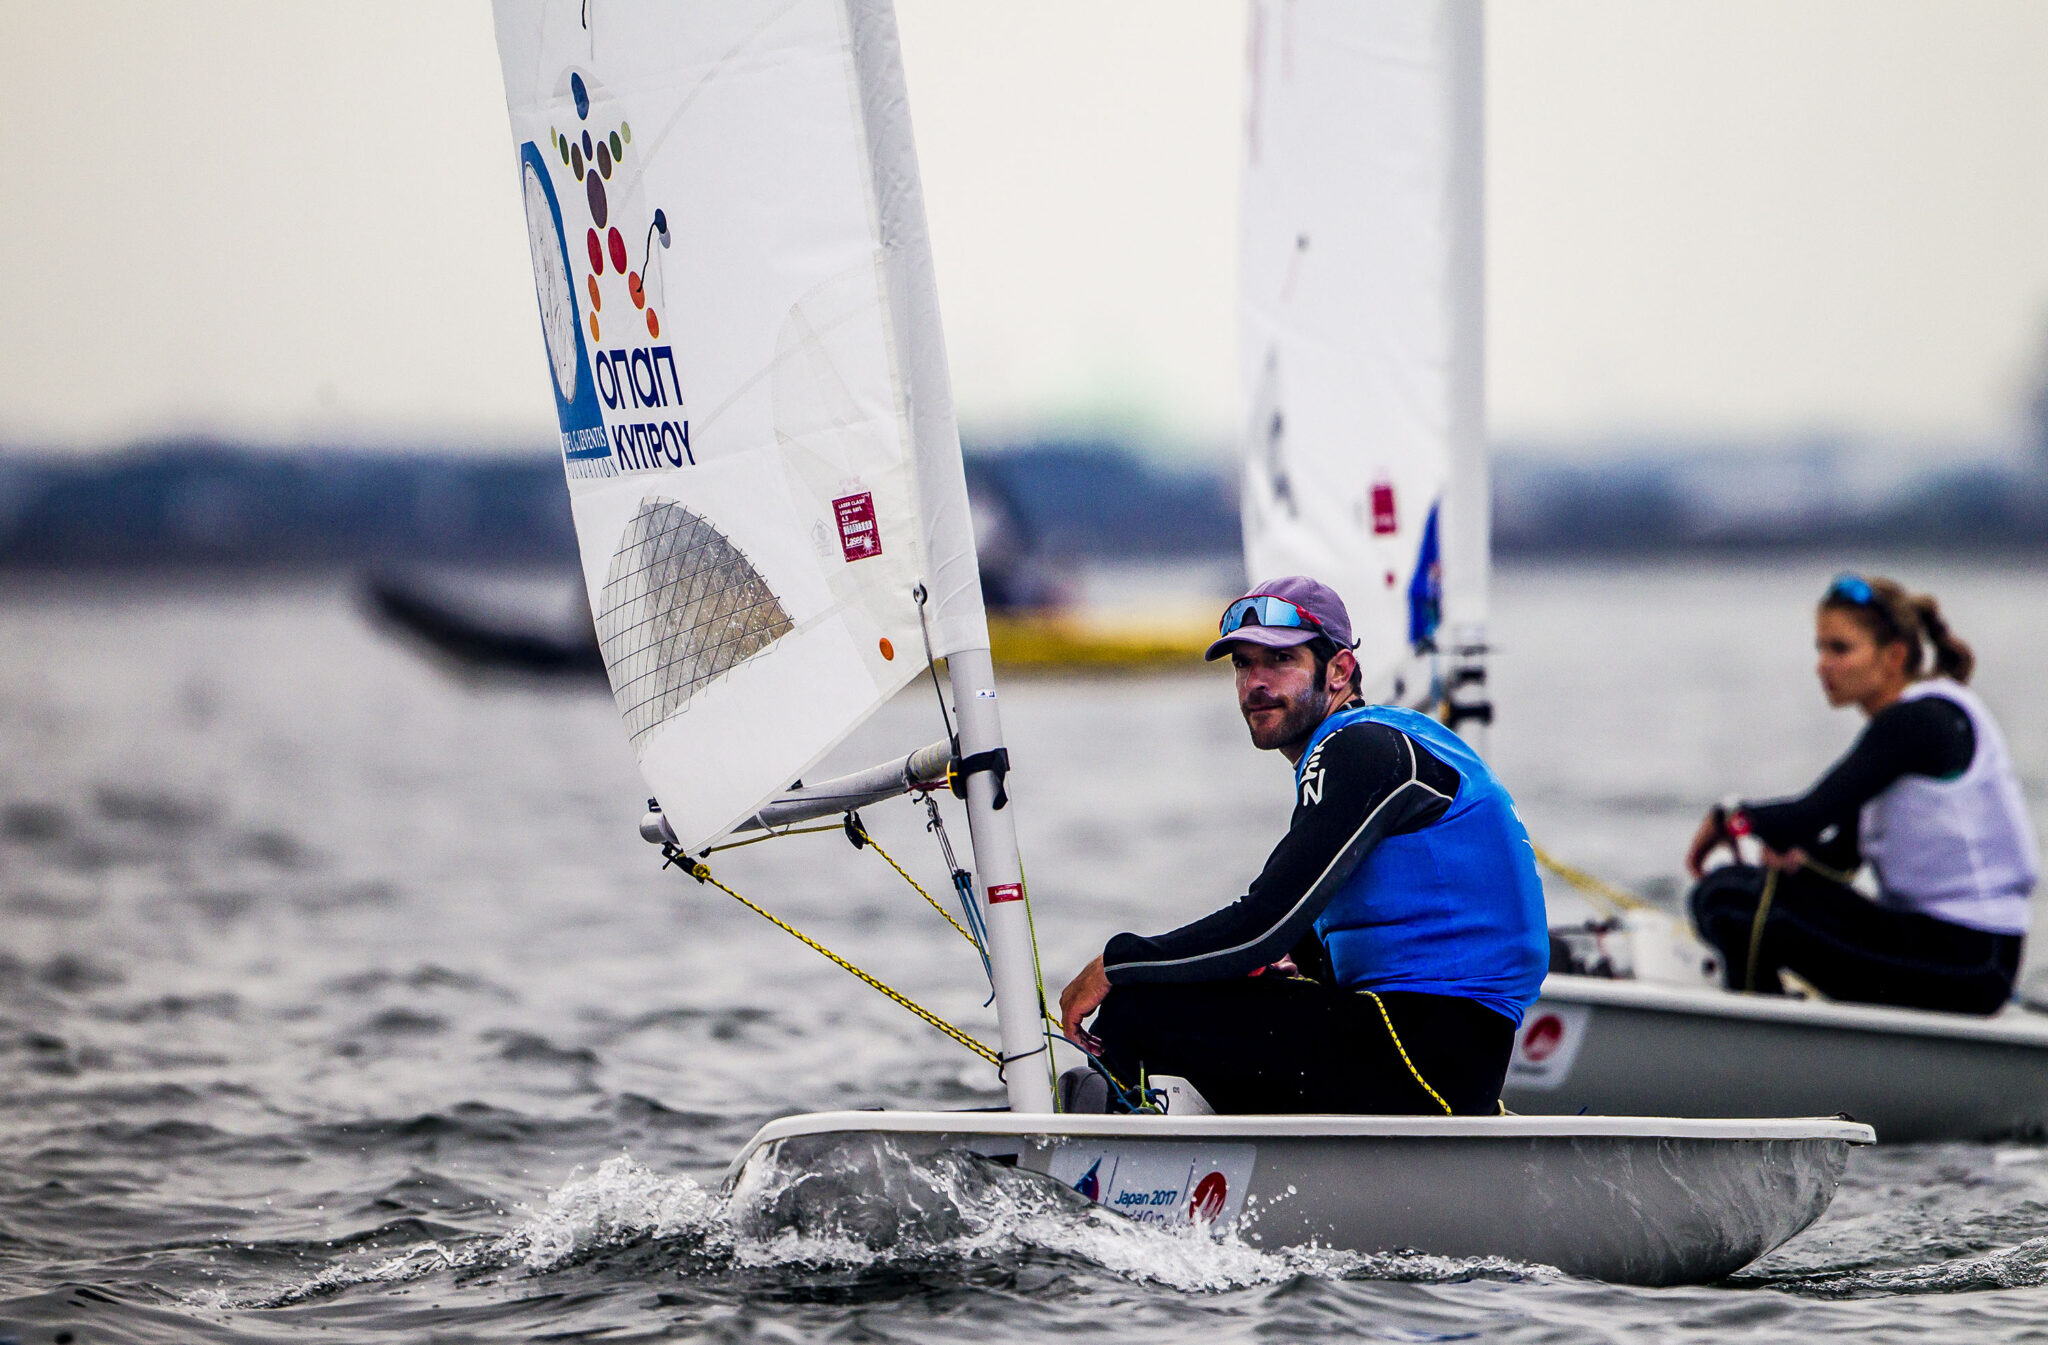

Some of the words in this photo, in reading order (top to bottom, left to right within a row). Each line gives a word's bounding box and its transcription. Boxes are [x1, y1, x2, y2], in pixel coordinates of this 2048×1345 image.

[611, 420, 696, 470] ΚΥΠΡΟΥ
[1114, 1189, 1149, 1208] Japan
[1150, 1190, 1178, 1206] 2017
